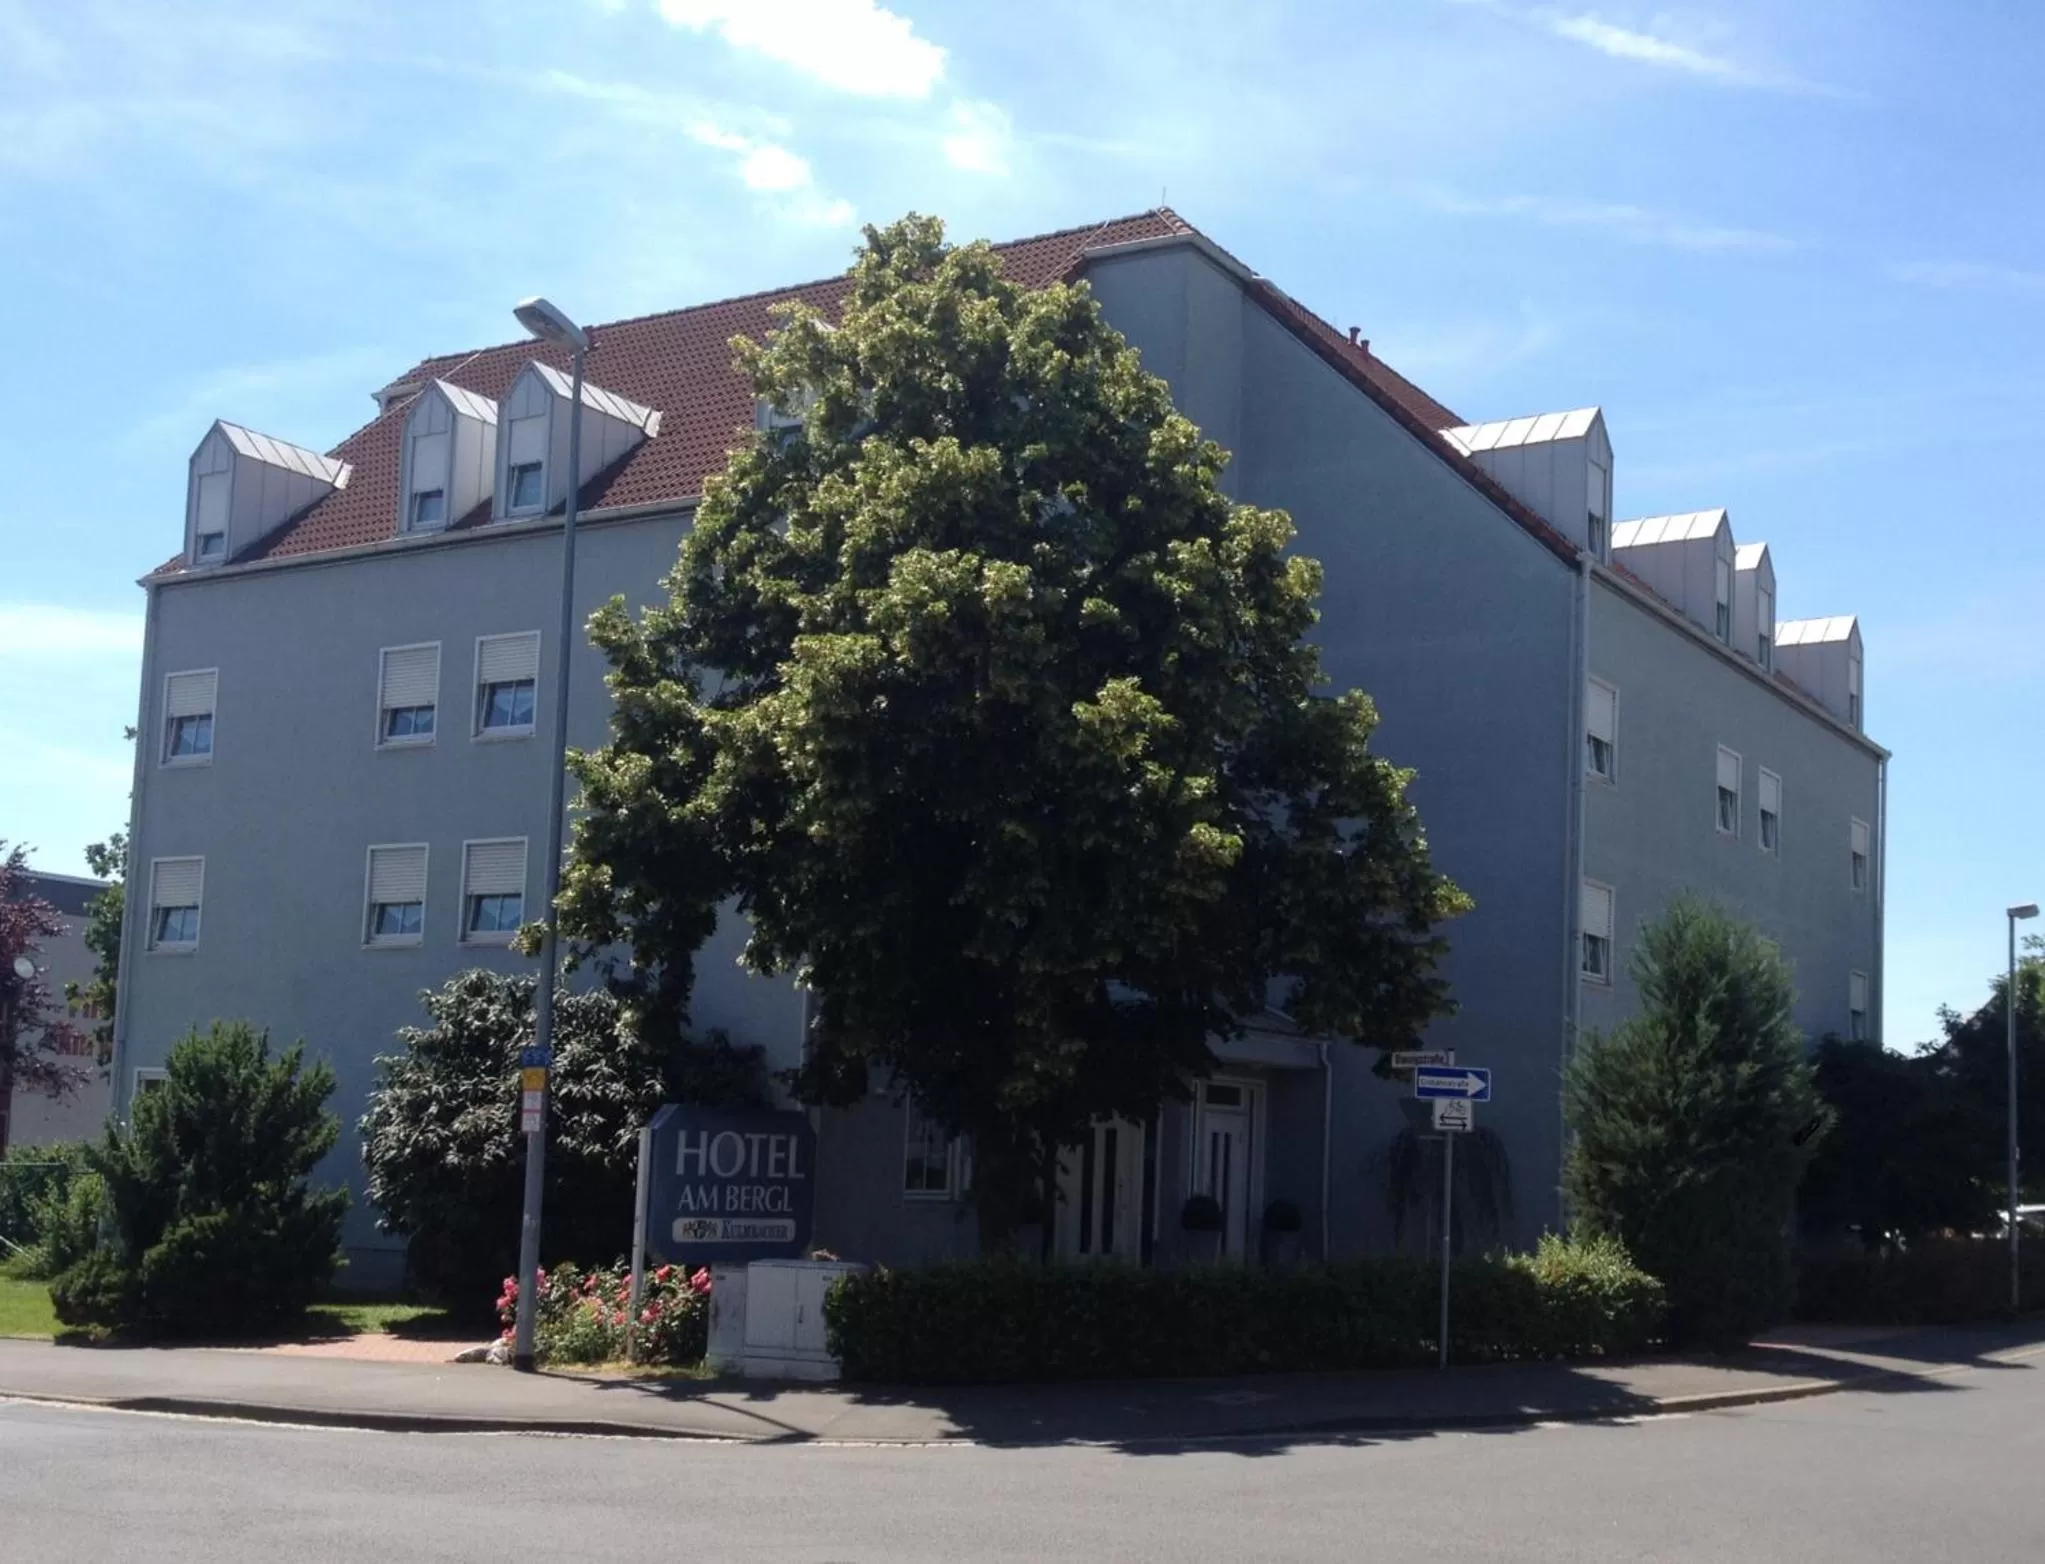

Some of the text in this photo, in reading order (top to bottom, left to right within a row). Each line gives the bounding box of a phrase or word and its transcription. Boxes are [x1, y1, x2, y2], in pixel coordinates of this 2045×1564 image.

[675, 1129, 805, 1179] HOTEL
[677, 1184, 793, 1212] AM BERGL
